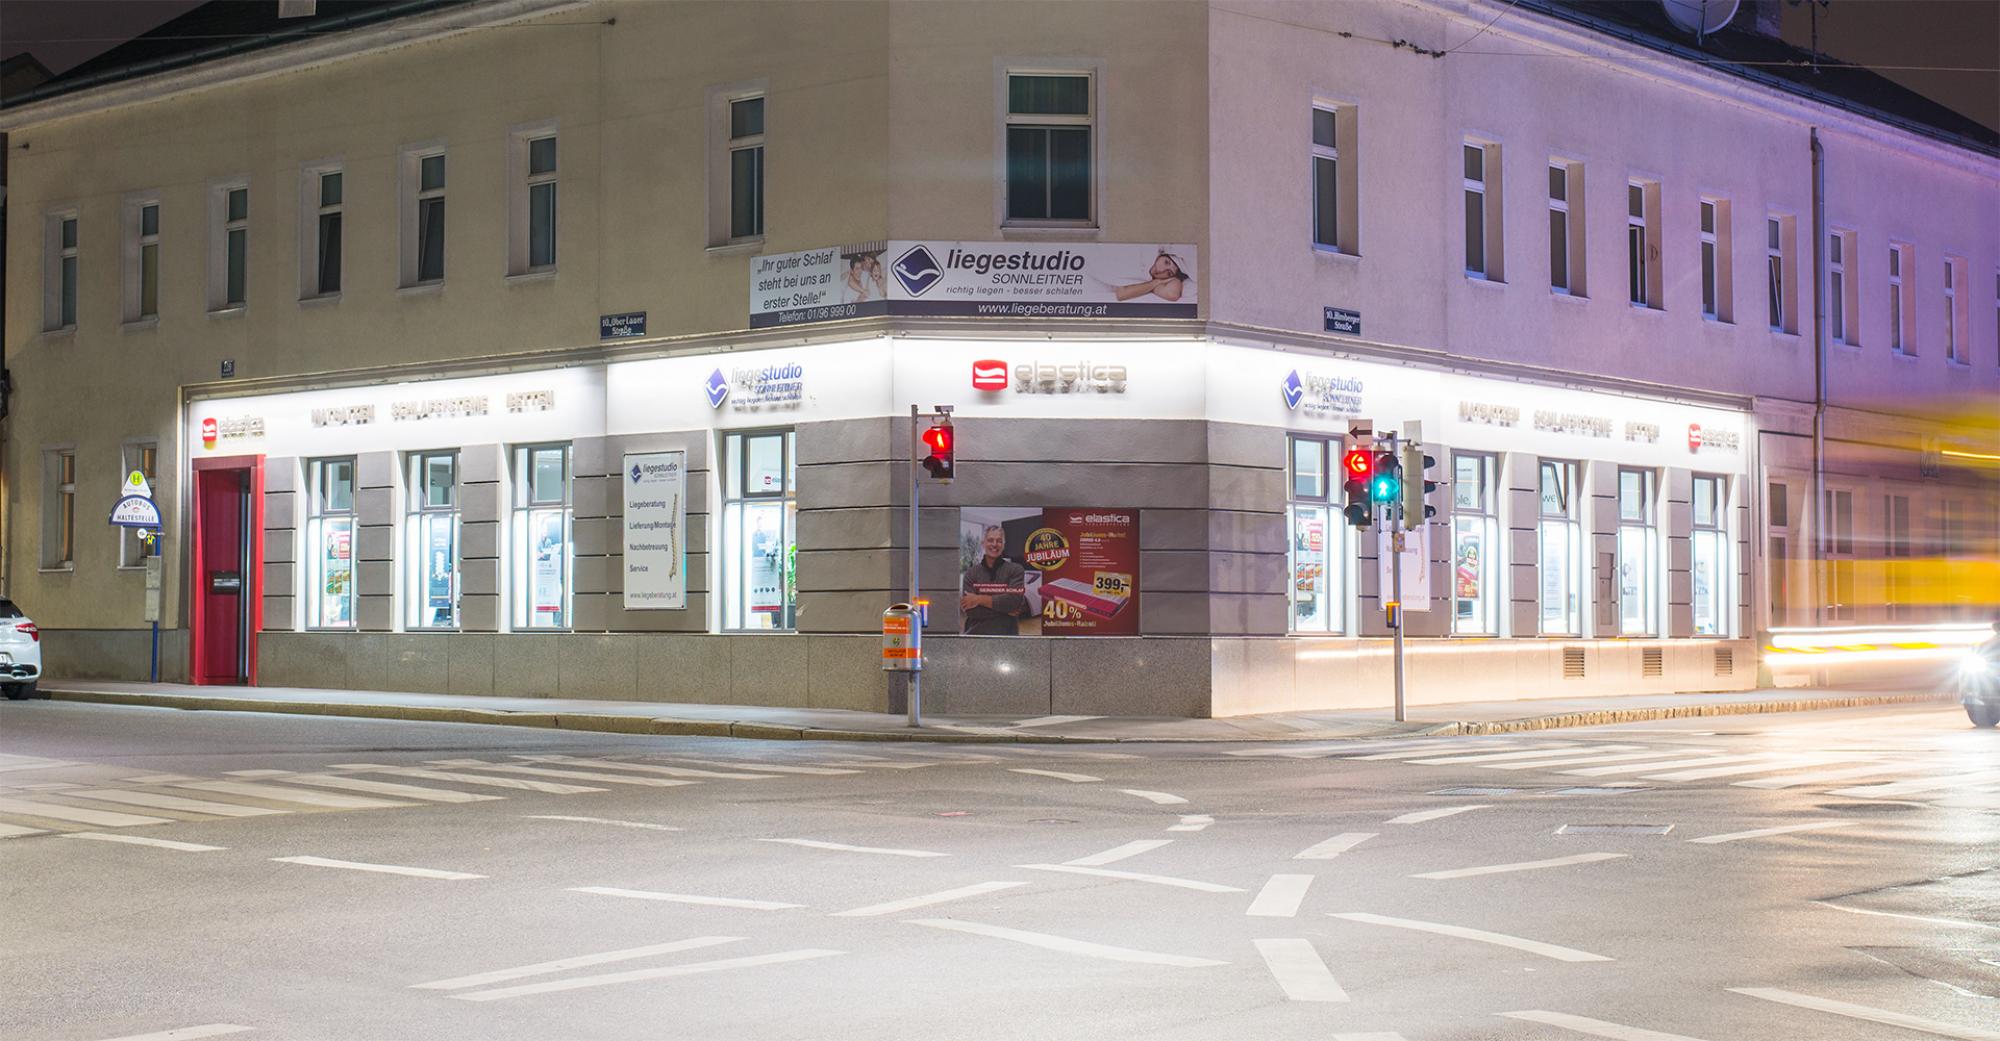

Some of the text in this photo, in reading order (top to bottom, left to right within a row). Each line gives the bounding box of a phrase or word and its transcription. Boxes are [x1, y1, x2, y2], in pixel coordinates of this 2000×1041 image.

[777, 257, 801, 273] guter
[803, 250, 834, 267] Schlaf
[947, 249, 1085, 275] liegestudio
[758, 273, 831, 291] steht bei uns an
[992, 274, 1084, 285] SONNLEITNER
[946, 286, 975, 296] richtig
[976, 286, 1004, 296] liegen
[1013, 286, 1043, 295] besser
[1045, 286, 1083, 296] schlafen
[763, 295, 790, 310] erster
[778, 304, 857, 322] Telefon: 01/96 999 00
[978, 303, 1107, 317] www.liegeberatung.at
[731, 362, 803, 385] liegestudio
[1014, 360, 1127, 381] elastica
[643, 462, 678, 474] liegestudio
[629, 500, 666, 509] Liegeberatung
[117, 514, 155, 522] HALTESTELLE
[1085, 513, 1130, 523] elastica
[1041, 533, 1052, 541] 40
[629, 544, 668, 552] Nachbetreuung
[1034, 541, 1060, 551] JAHRE
[1026, 548, 1071, 562] JUBILÄUM
